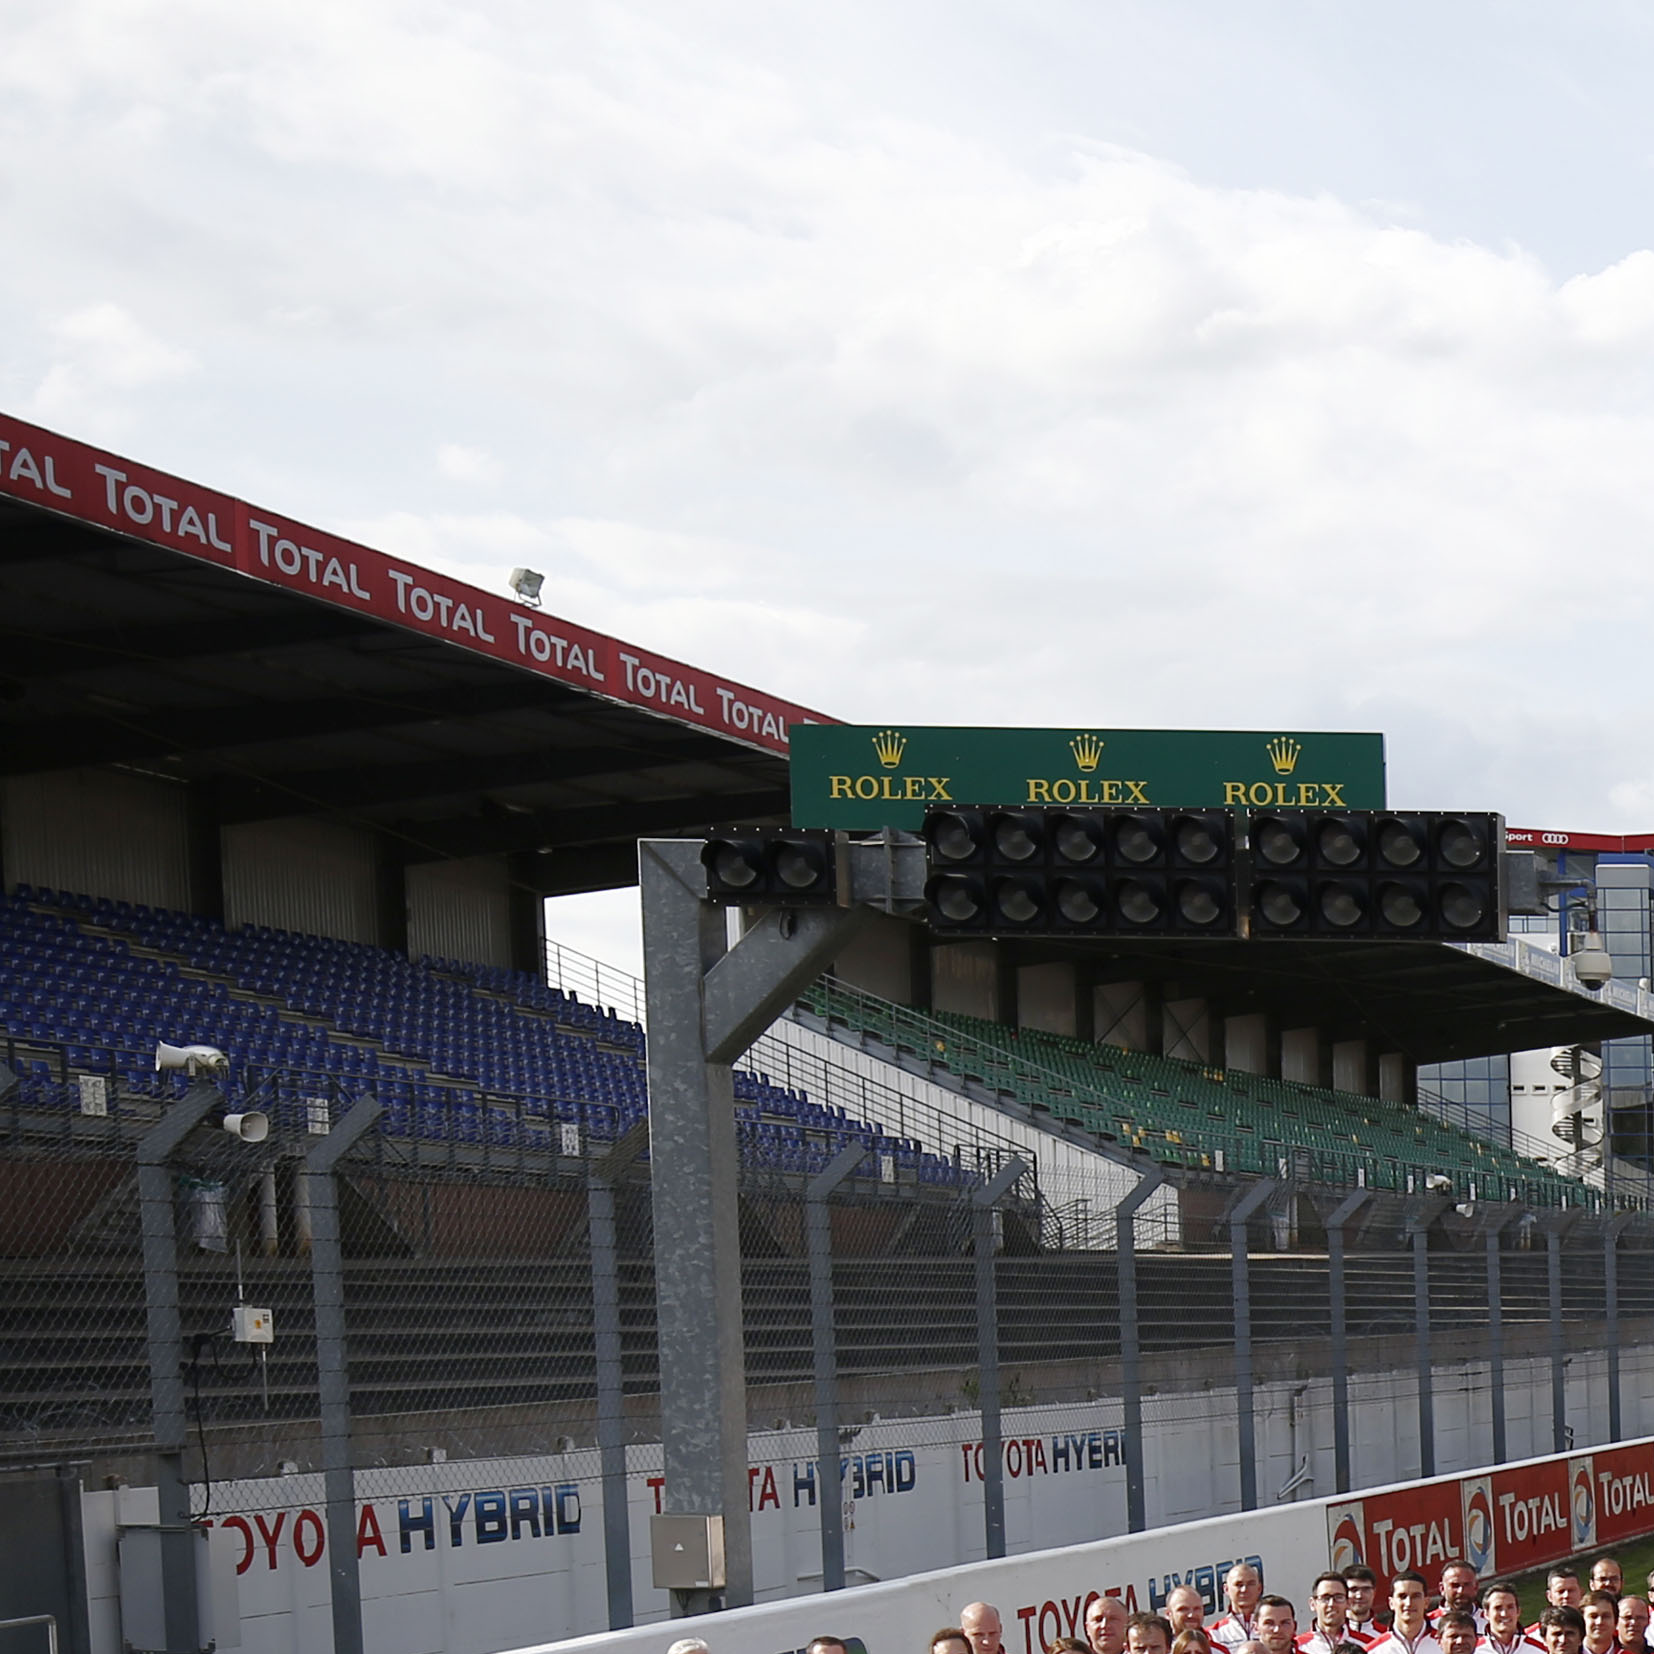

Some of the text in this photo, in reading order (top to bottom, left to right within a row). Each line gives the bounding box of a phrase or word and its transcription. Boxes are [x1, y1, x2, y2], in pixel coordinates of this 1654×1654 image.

[95, 463, 231, 552] TOTAL
[249, 519, 370, 600] TOTAL
[389, 569, 494, 642] TOTAL
[510, 613, 604, 681] TOTAL
[619, 652, 704, 714] TOTAL
[716, 687, 789, 743] TOTAL
[829, 776, 952, 801] ROLEX
[1026, 779, 1150, 804] ROLEX
[1223, 782, 1346, 807] ROLEX
[399, 1484, 581, 1553] HYBRID
[1500, 1492, 1567, 1543] TOTAL
[1599, 1471, 1654, 1517] TOTAL
[1373, 1518, 1460, 1577] TOTAL
